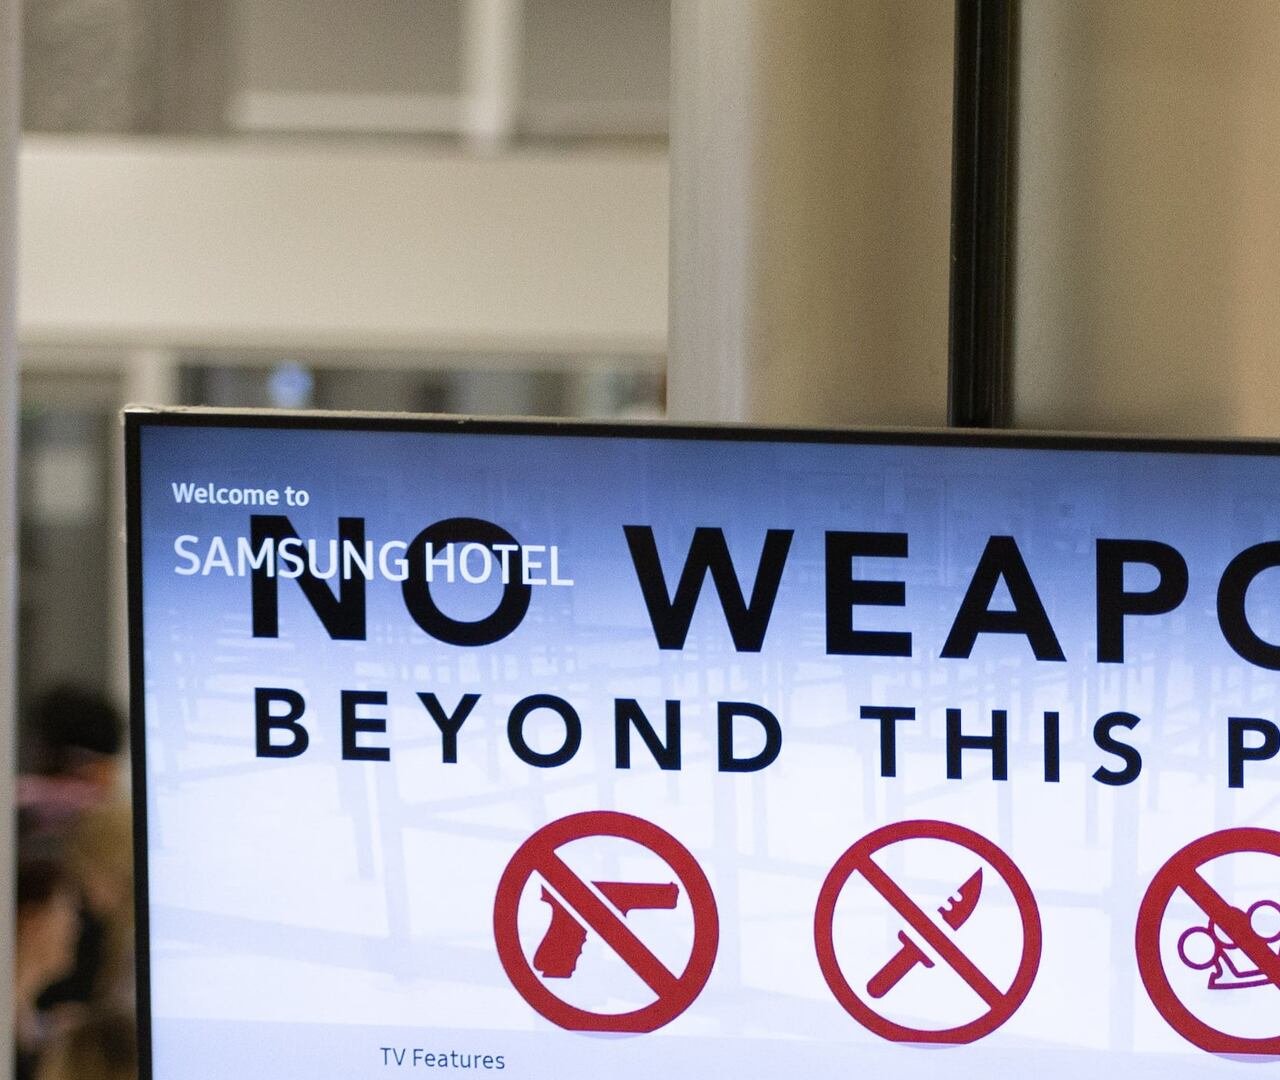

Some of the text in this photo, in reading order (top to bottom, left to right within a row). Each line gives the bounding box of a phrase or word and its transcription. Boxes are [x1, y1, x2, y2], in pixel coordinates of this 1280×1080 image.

[171, 482, 310, 507] Welcome to
[173, 534, 575, 587] SAMSUNG HOTEL
[249, 513, 532, 648] NO
[255, 686, 783, 773] BEYOND
[860, 705, 1143, 787] THIS
[380, 1047, 506, 1070] TV Features
